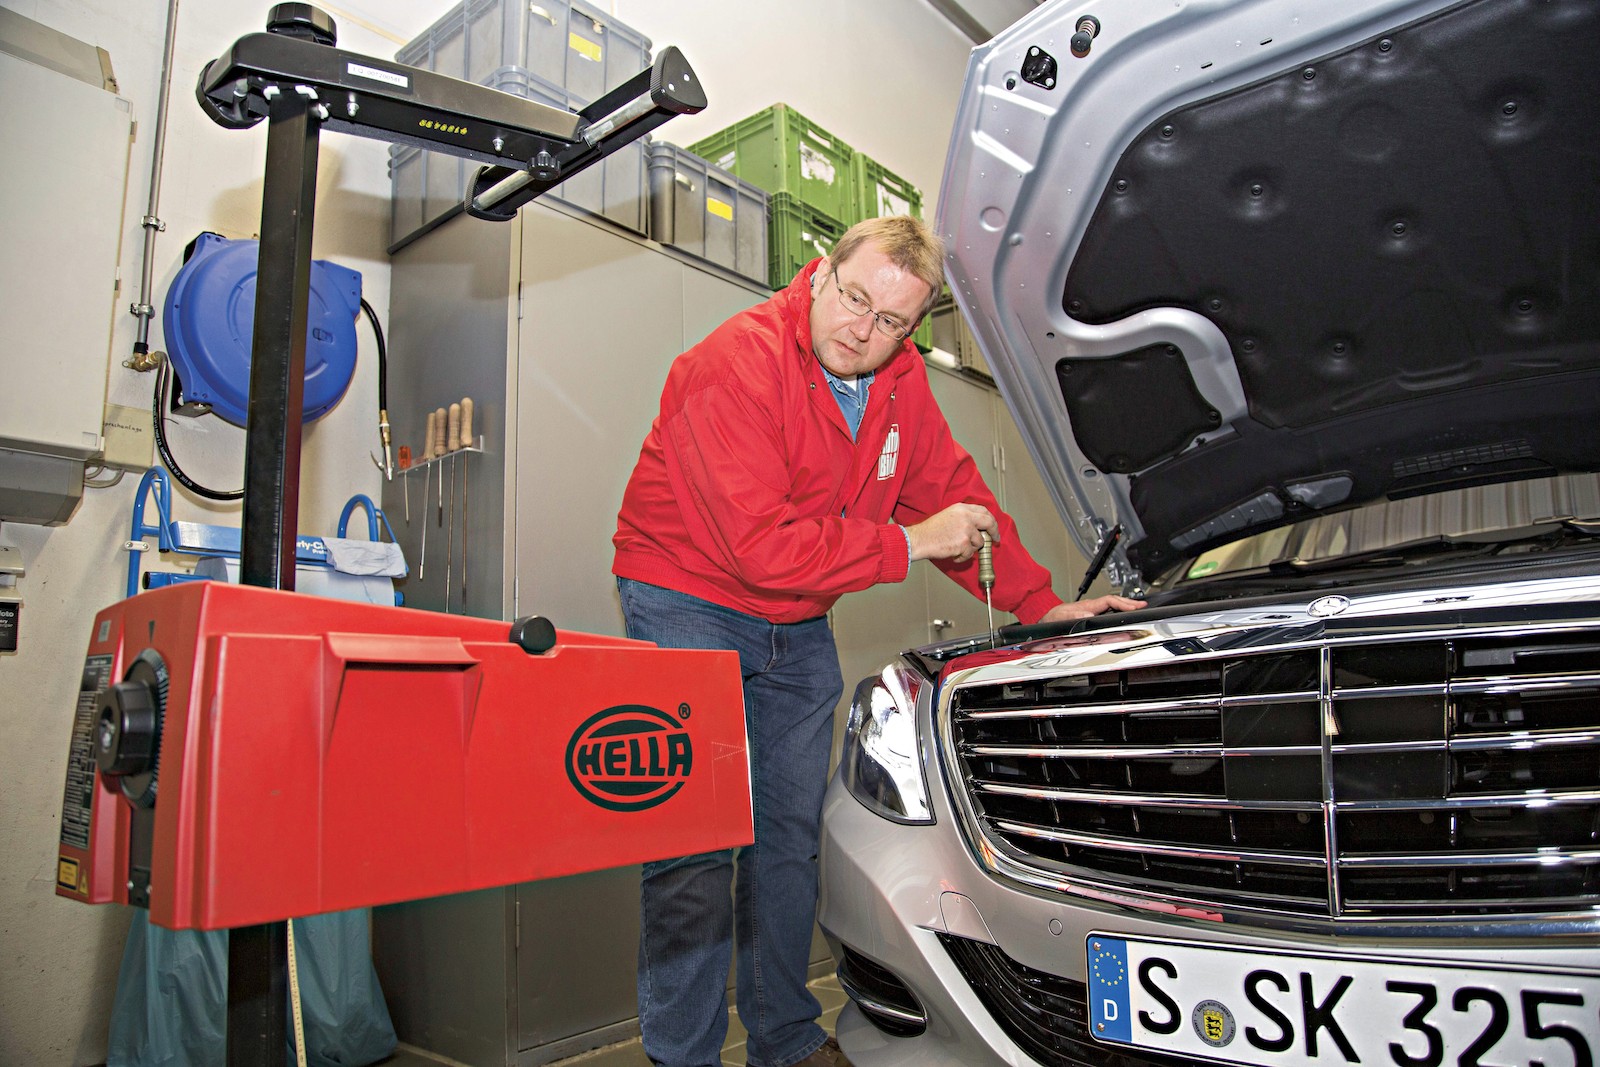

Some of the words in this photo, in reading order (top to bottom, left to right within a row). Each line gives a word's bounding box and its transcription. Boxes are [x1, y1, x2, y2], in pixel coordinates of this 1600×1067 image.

[577, 733, 693, 776] HELLA
[1103, 998, 1119, 1021] D
[1138, 957, 1181, 1035] S
[1244, 969, 1361, 1063] SK
[1386, 980, 1594, 1067] 325
